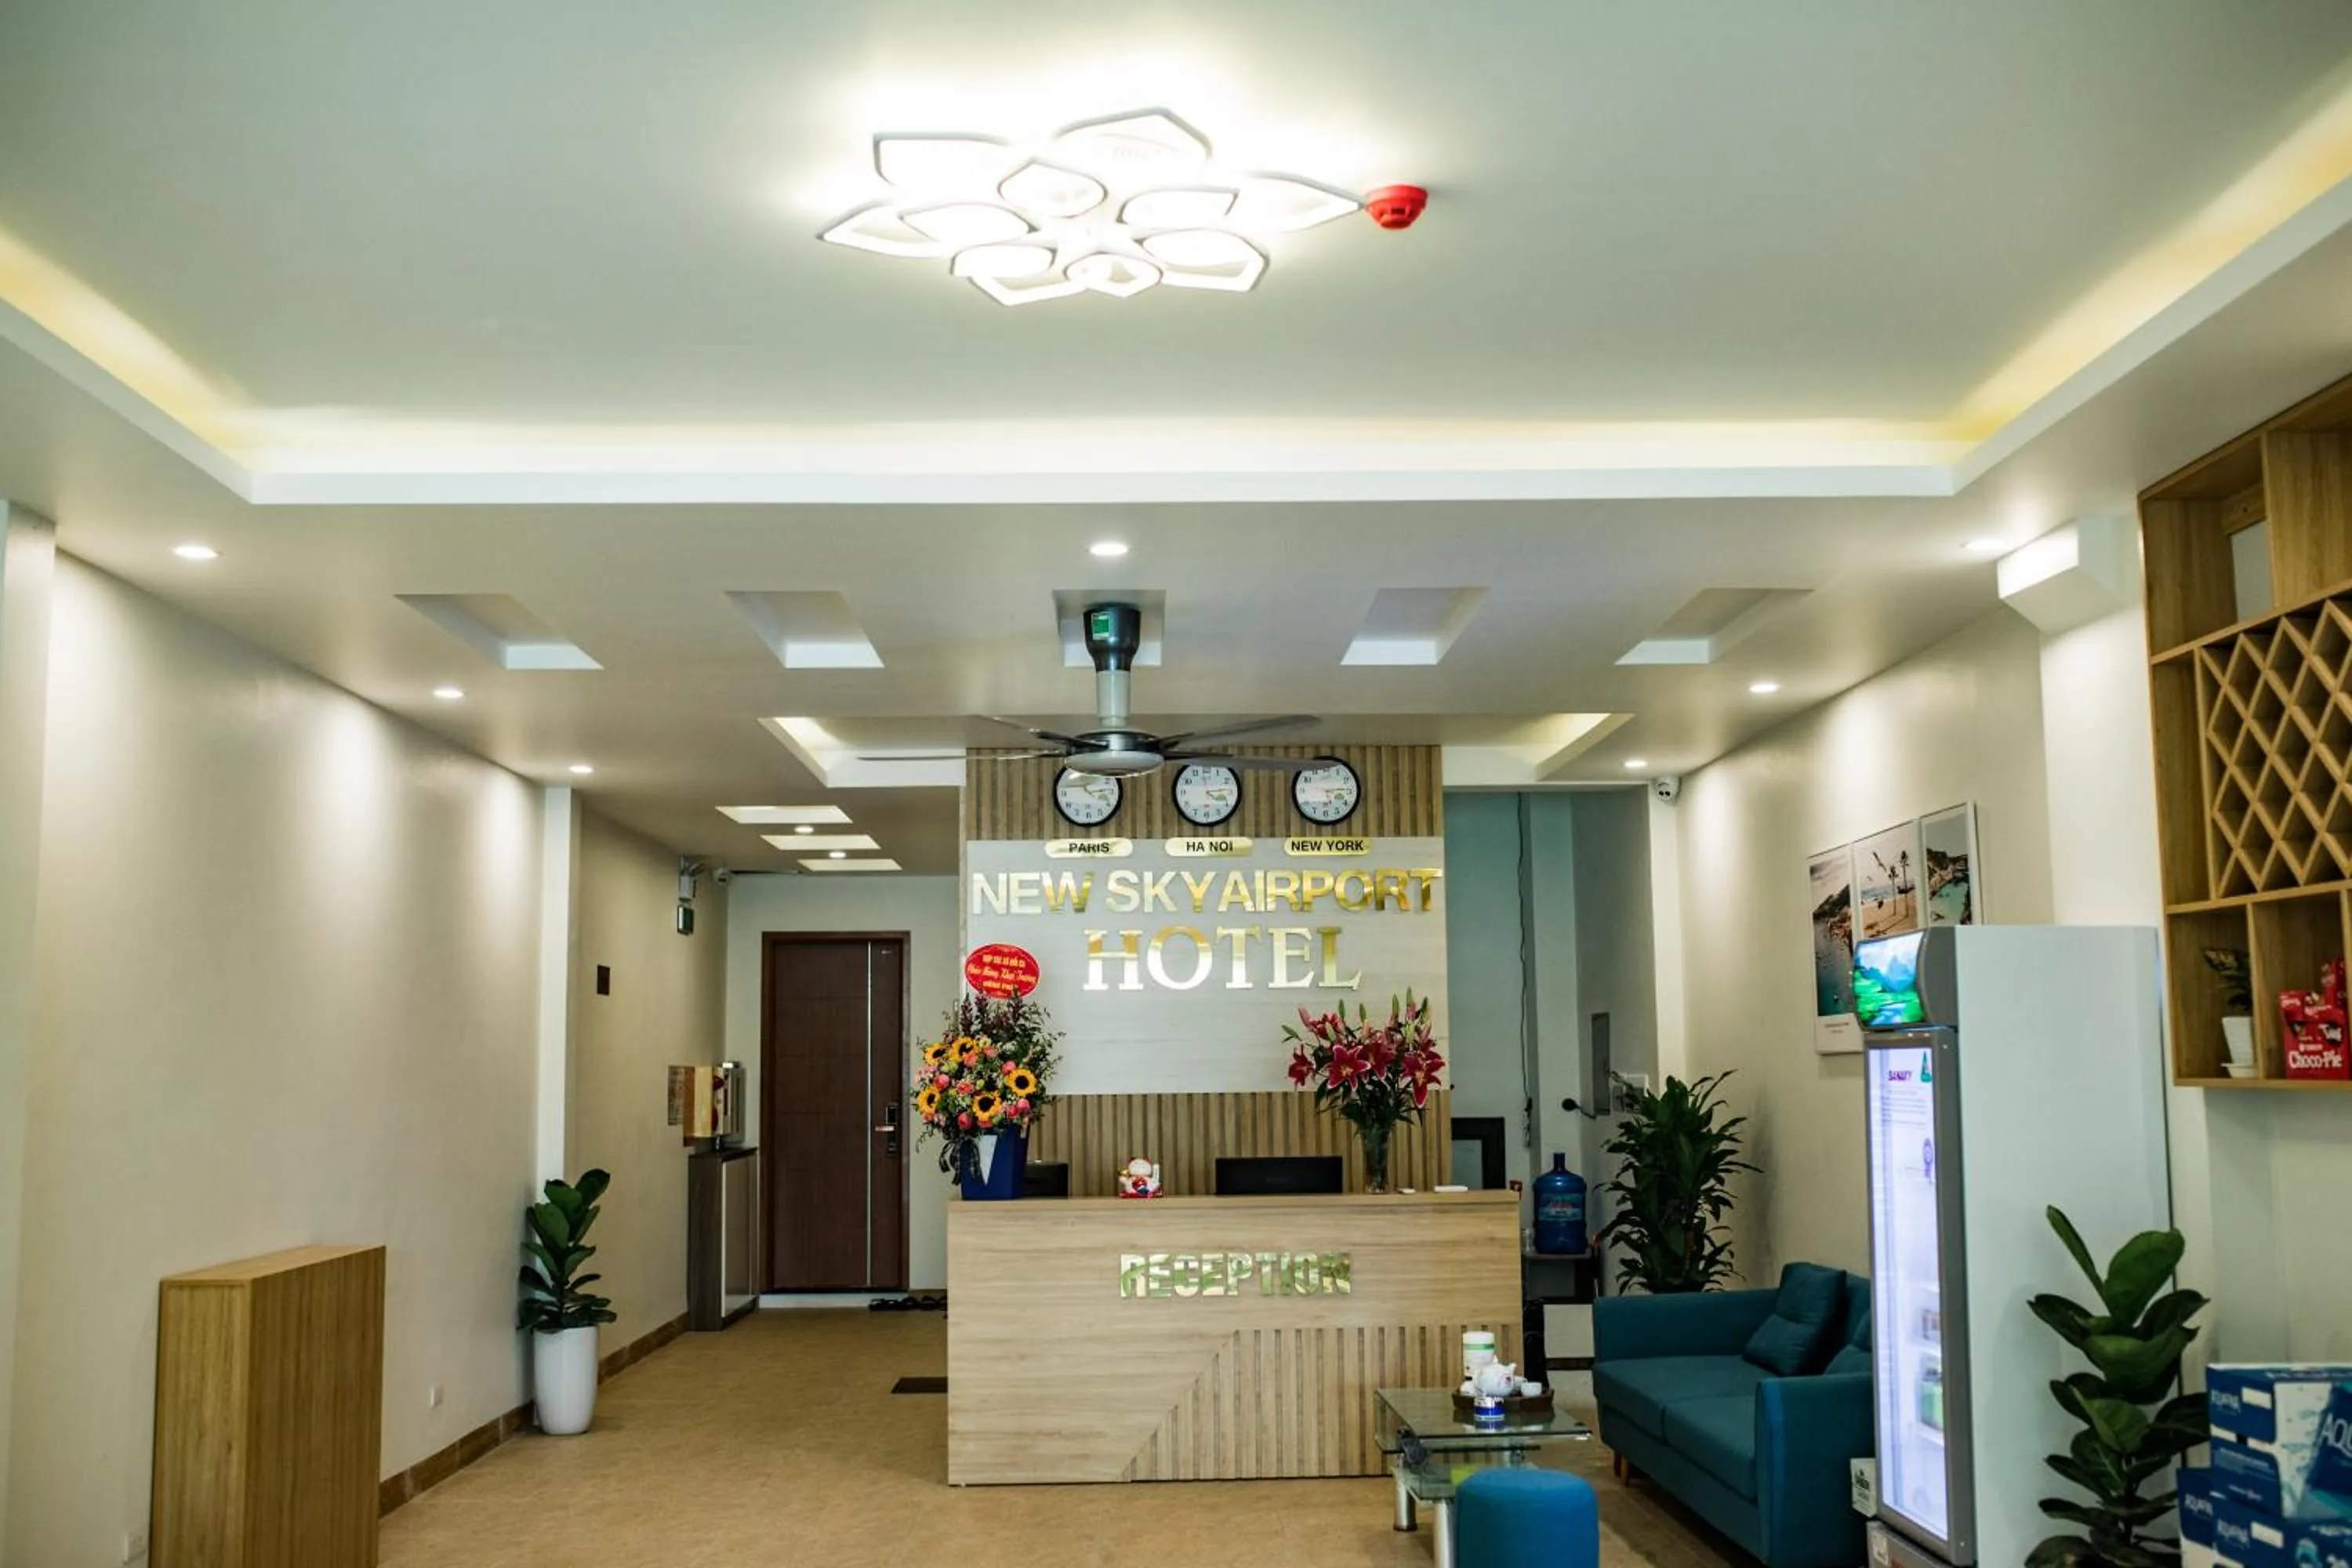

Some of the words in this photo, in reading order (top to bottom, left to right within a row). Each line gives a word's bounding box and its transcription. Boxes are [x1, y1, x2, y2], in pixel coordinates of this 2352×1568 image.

[1069, 841, 1110, 854] PARIS
[1185, 841, 1205, 852] HA
[1209, 840, 1234, 852] NOI
[1290, 840, 1323, 851] NEW
[1326, 840, 1364, 851] YORK
[973, 871, 1094, 913] NEW
[1083, 925, 1361, 991] HOTEL
[1120, 1252, 1351, 1298] RECEPTION
